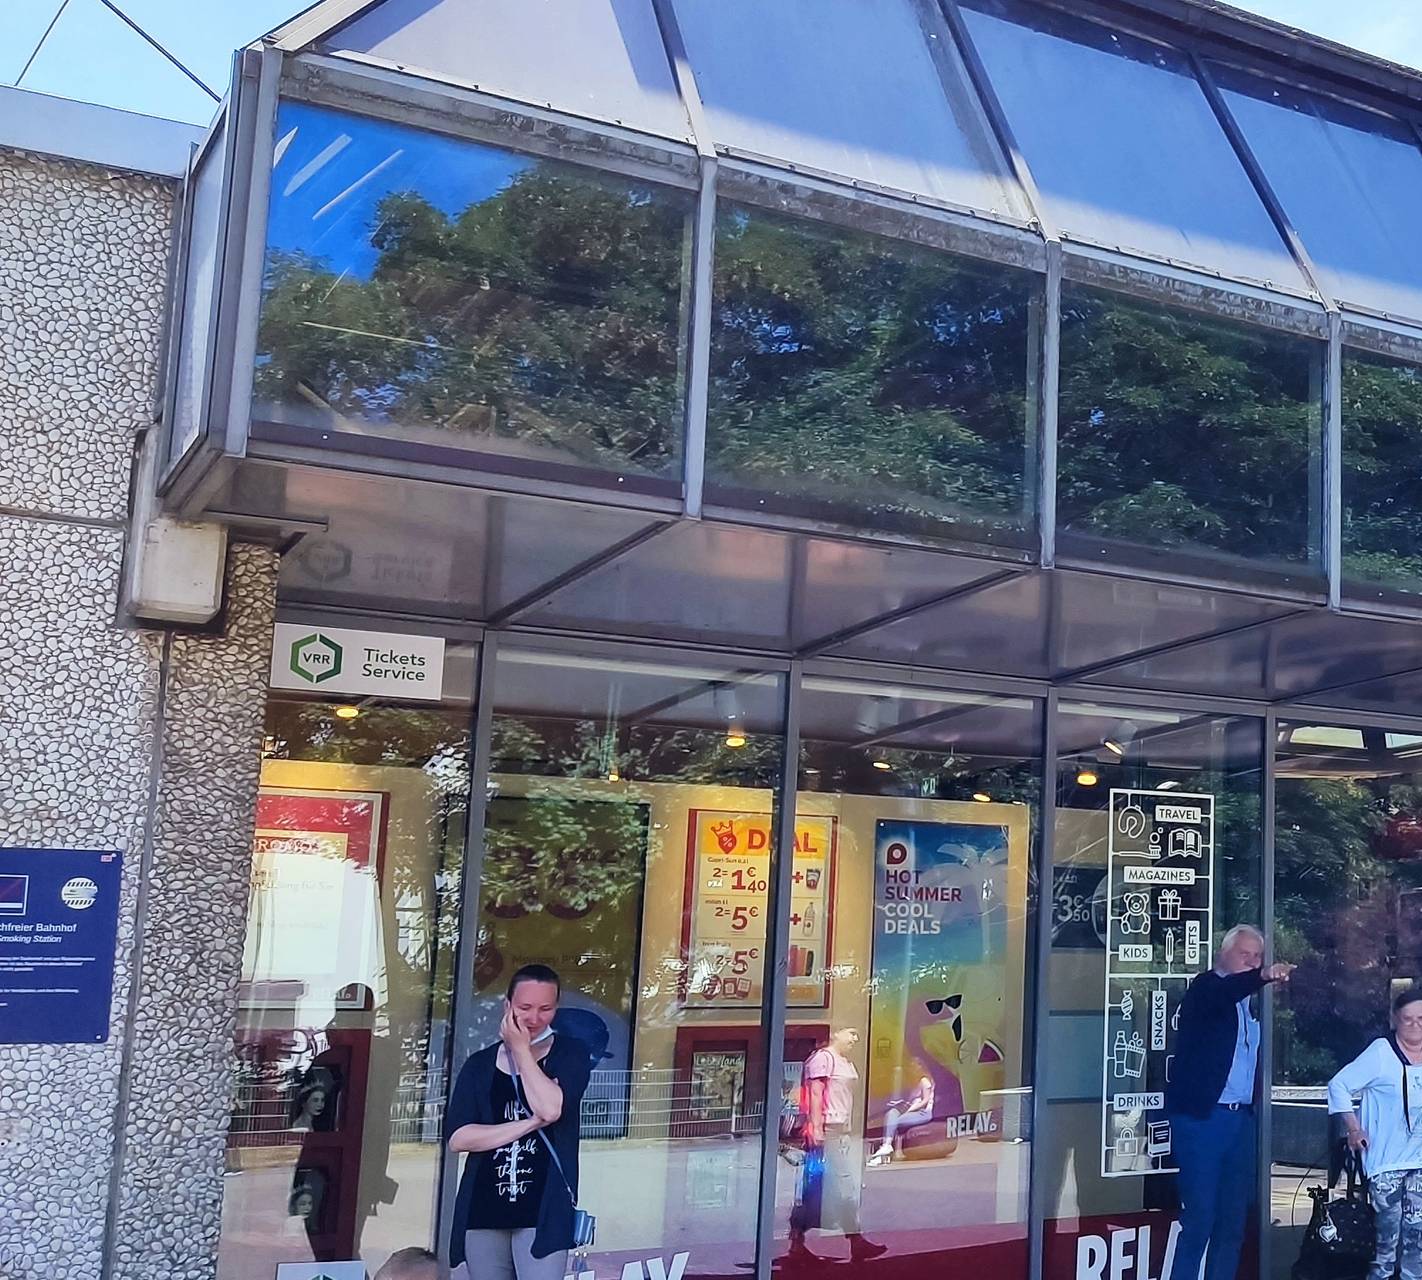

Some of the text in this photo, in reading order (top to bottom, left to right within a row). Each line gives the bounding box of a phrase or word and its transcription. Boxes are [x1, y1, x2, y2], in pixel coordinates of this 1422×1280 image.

[303, 652, 331, 665] VRR
[363, 648, 426, 667] Tickets
[362, 664, 426, 682] Service
[1159, 808, 1198, 821] TRAVEL
[747, 828, 818, 853] DAL
[886, 869, 923, 884] HOT
[1128, 868, 1191, 881] MAGAZINES
[885, 886, 962, 902] SUMMER
[884, 903, 934, 917] COOL
[36, 922, 77, 932] Bahnhof
[884, 919, 941, 935] DEALS
[33, 934, 62, 943] Station
[1188, 925, 1198, 959] GIFTS
[1123, 948, 1149, 959] KIDS
[1154, 994, 1164, 1046] SNACKS
[1118, 1096, 1160, 1108] DRINKS
[946, 1111, 993, 1138] RELAY
[1076, 1219, 1208, 1280] REL
